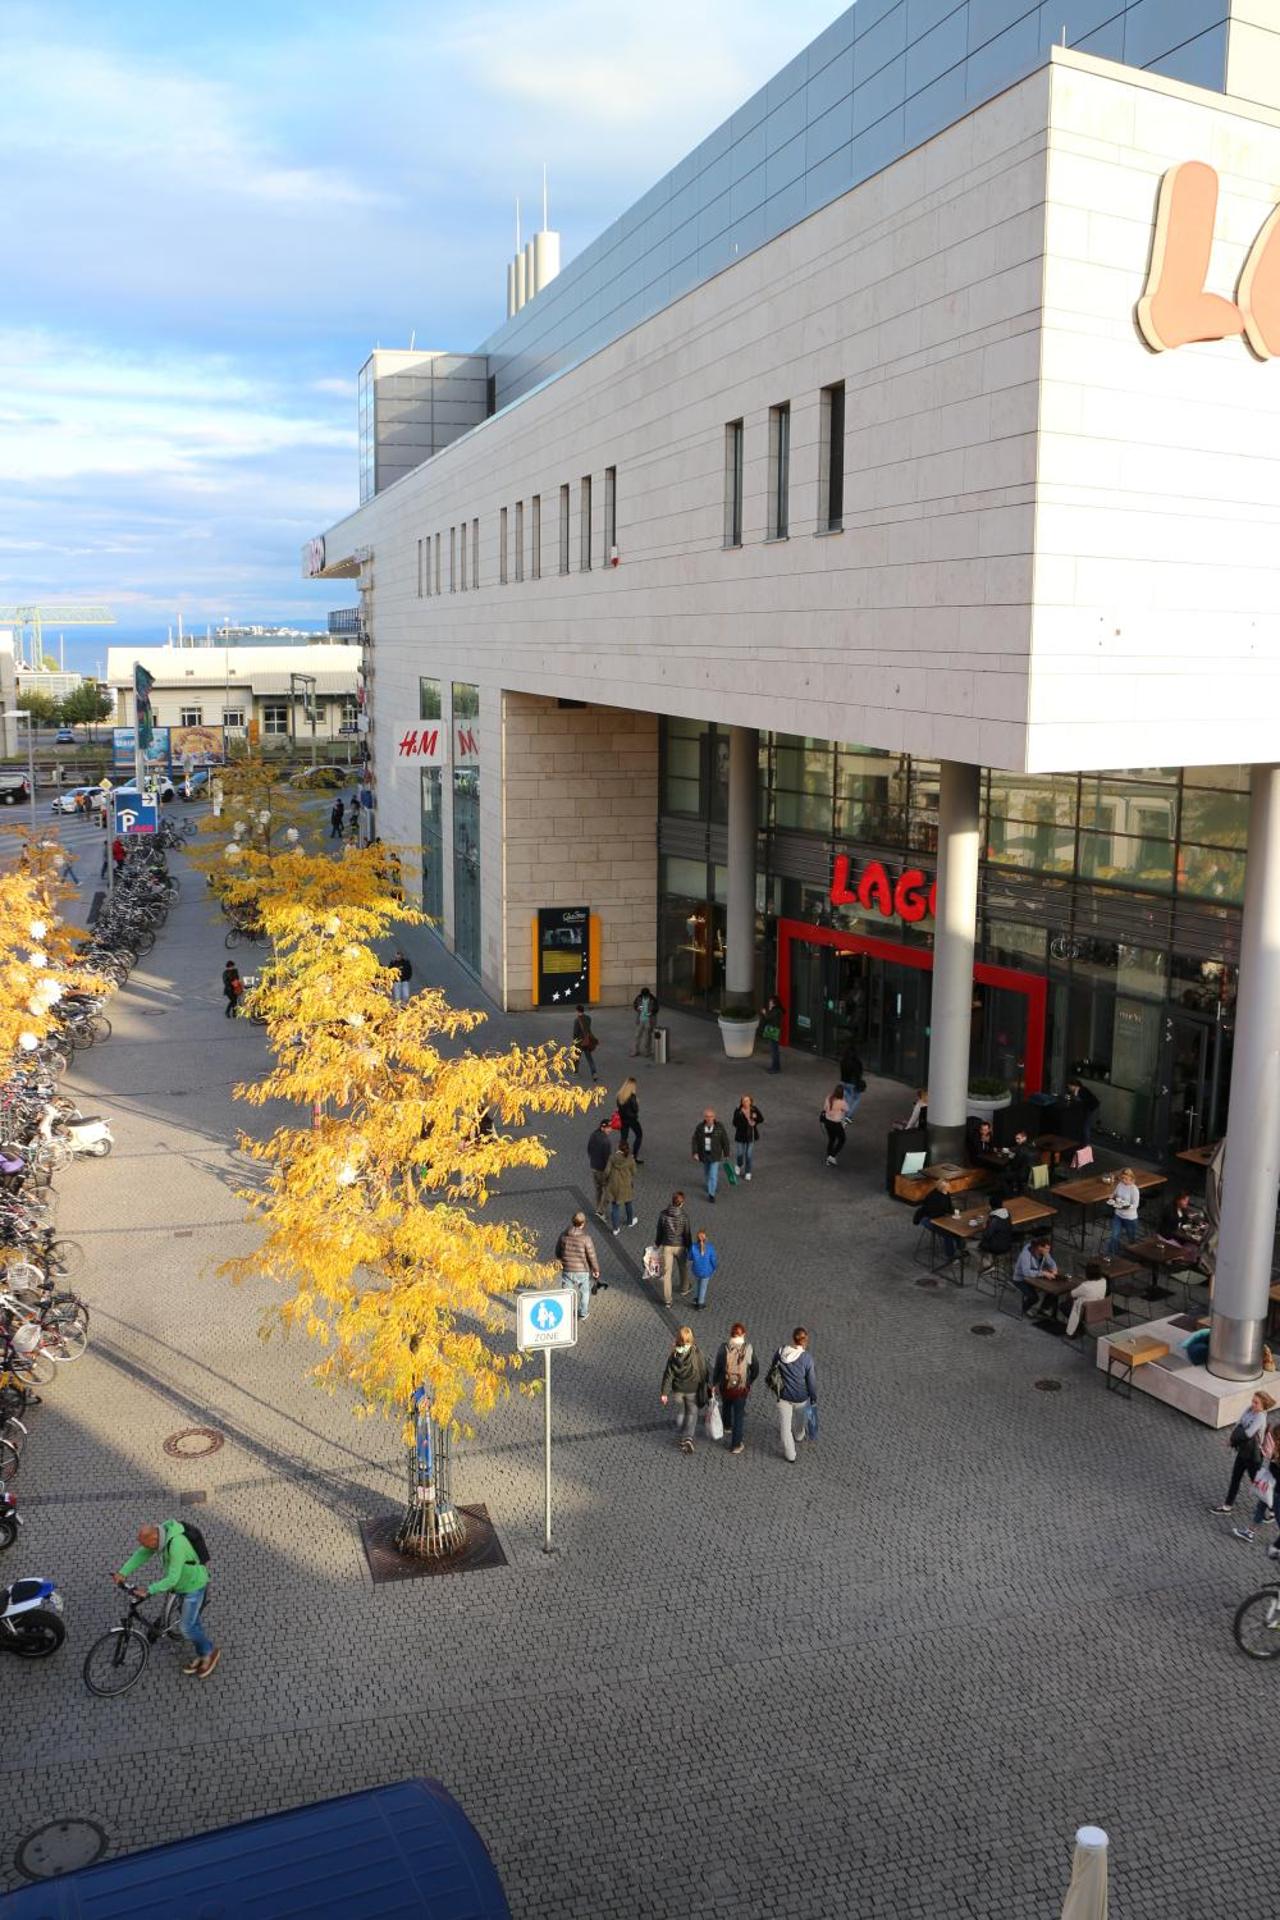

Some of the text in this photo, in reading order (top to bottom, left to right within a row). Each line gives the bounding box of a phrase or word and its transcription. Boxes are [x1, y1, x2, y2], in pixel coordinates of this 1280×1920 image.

[399, 729, 438, 757] H&M
[828, 852, 937, 923] LAG
[534, 1332, 560, 1342] ZONE
